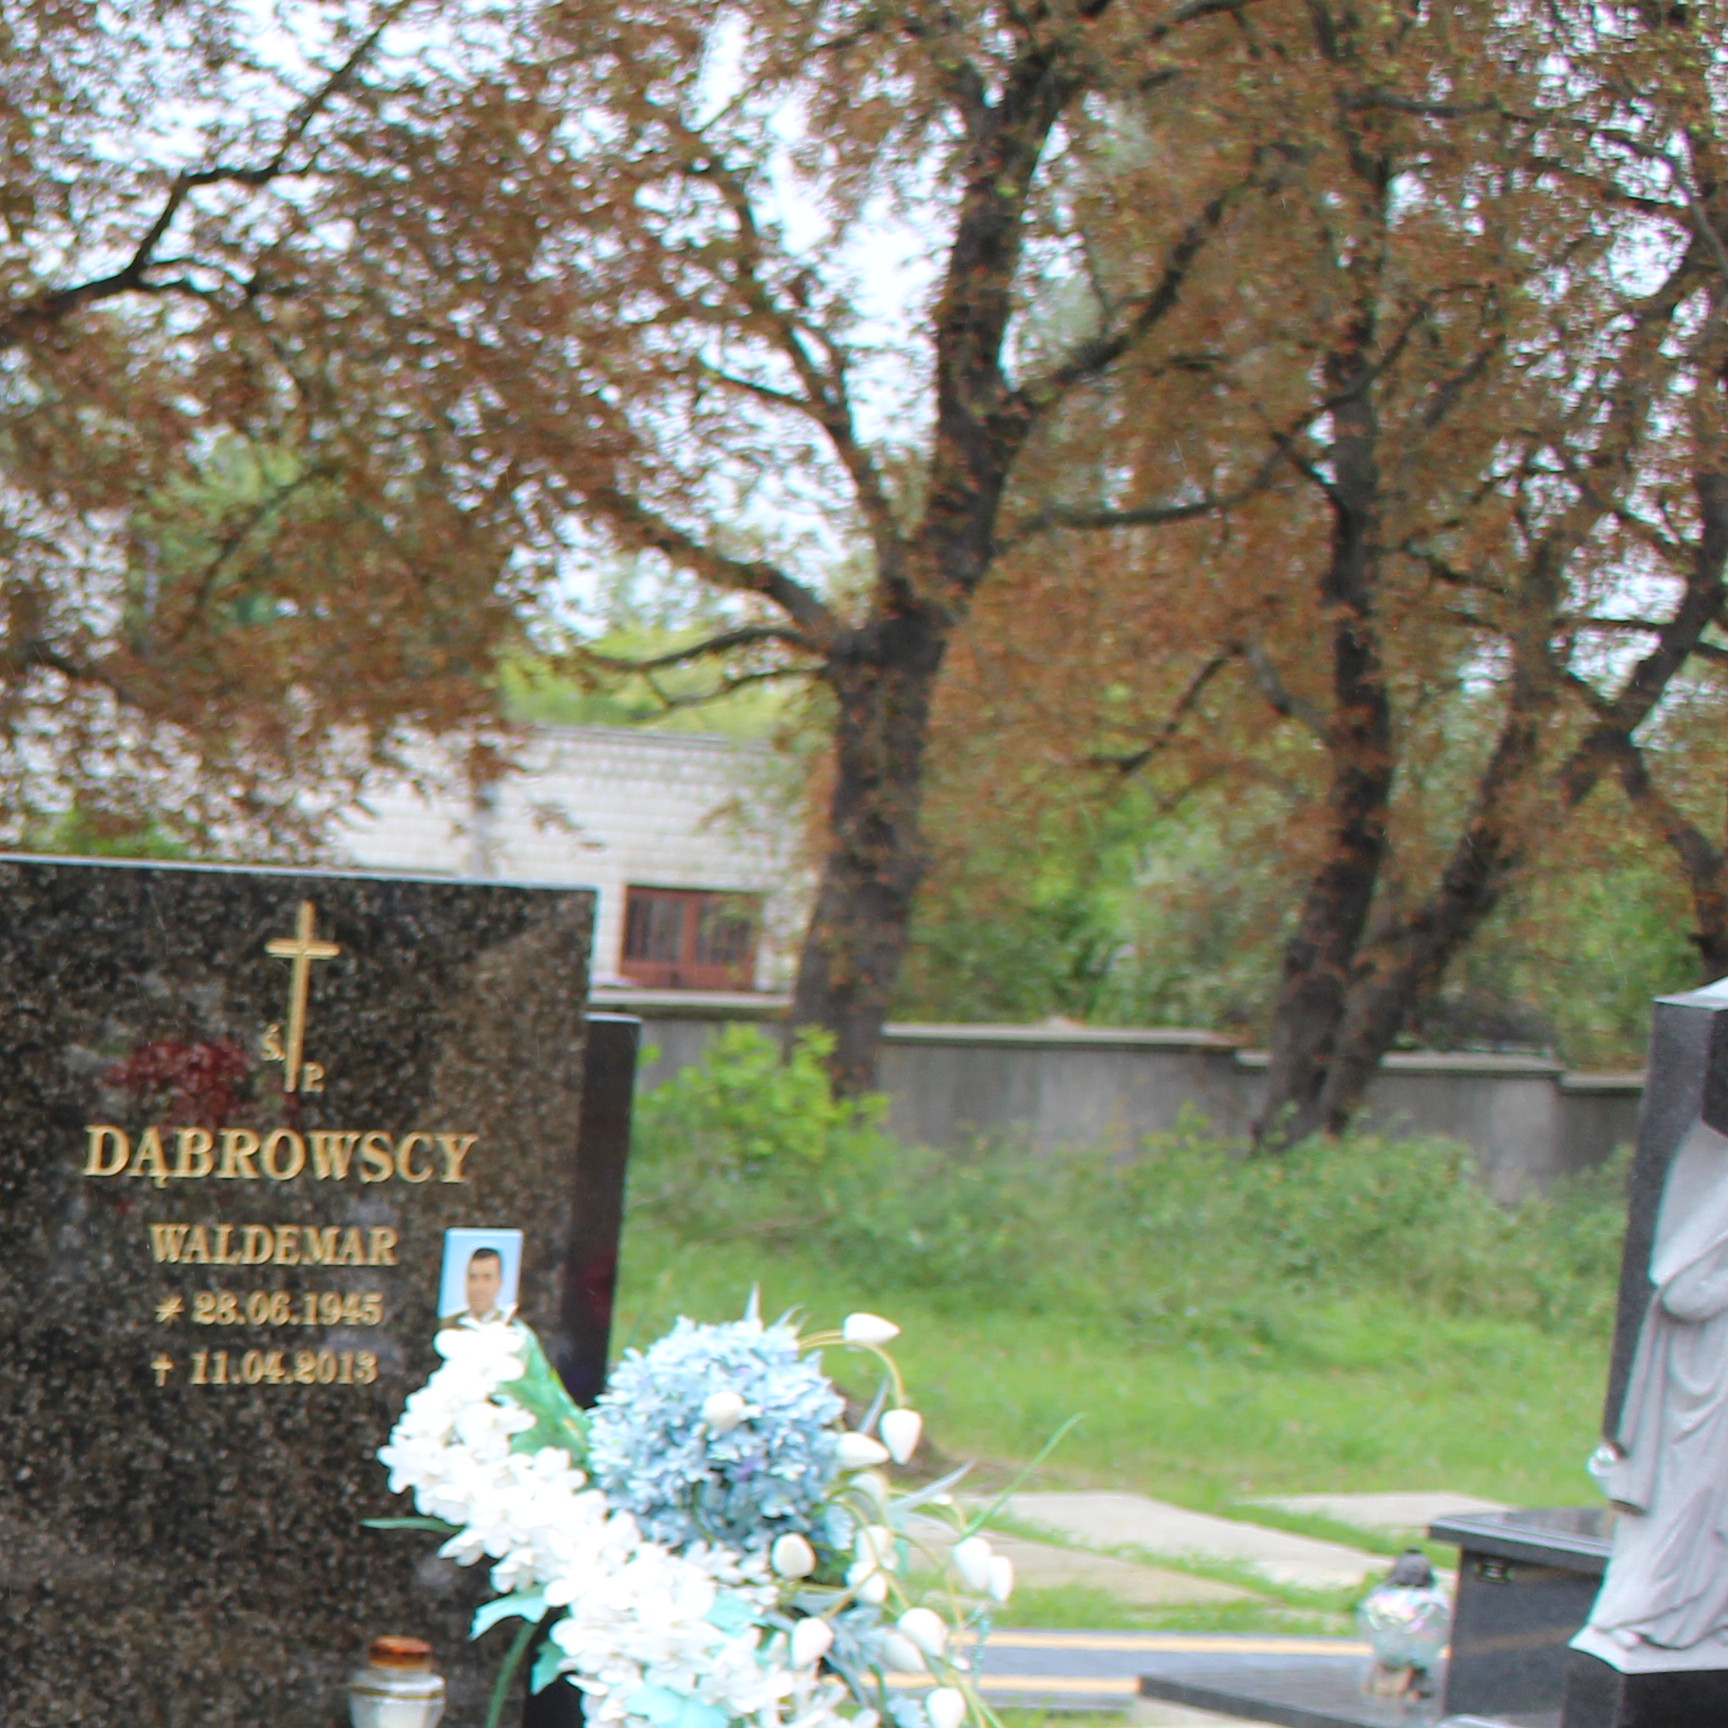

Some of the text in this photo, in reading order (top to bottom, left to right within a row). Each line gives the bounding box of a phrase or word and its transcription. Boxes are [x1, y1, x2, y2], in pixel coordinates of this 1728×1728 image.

[83, 1123, 479, 1188] DĄBROWSCY
[150, 1222, 398, 1267] WALDEMAR
[190, 1350, 378, 1386] 11.04.2013
